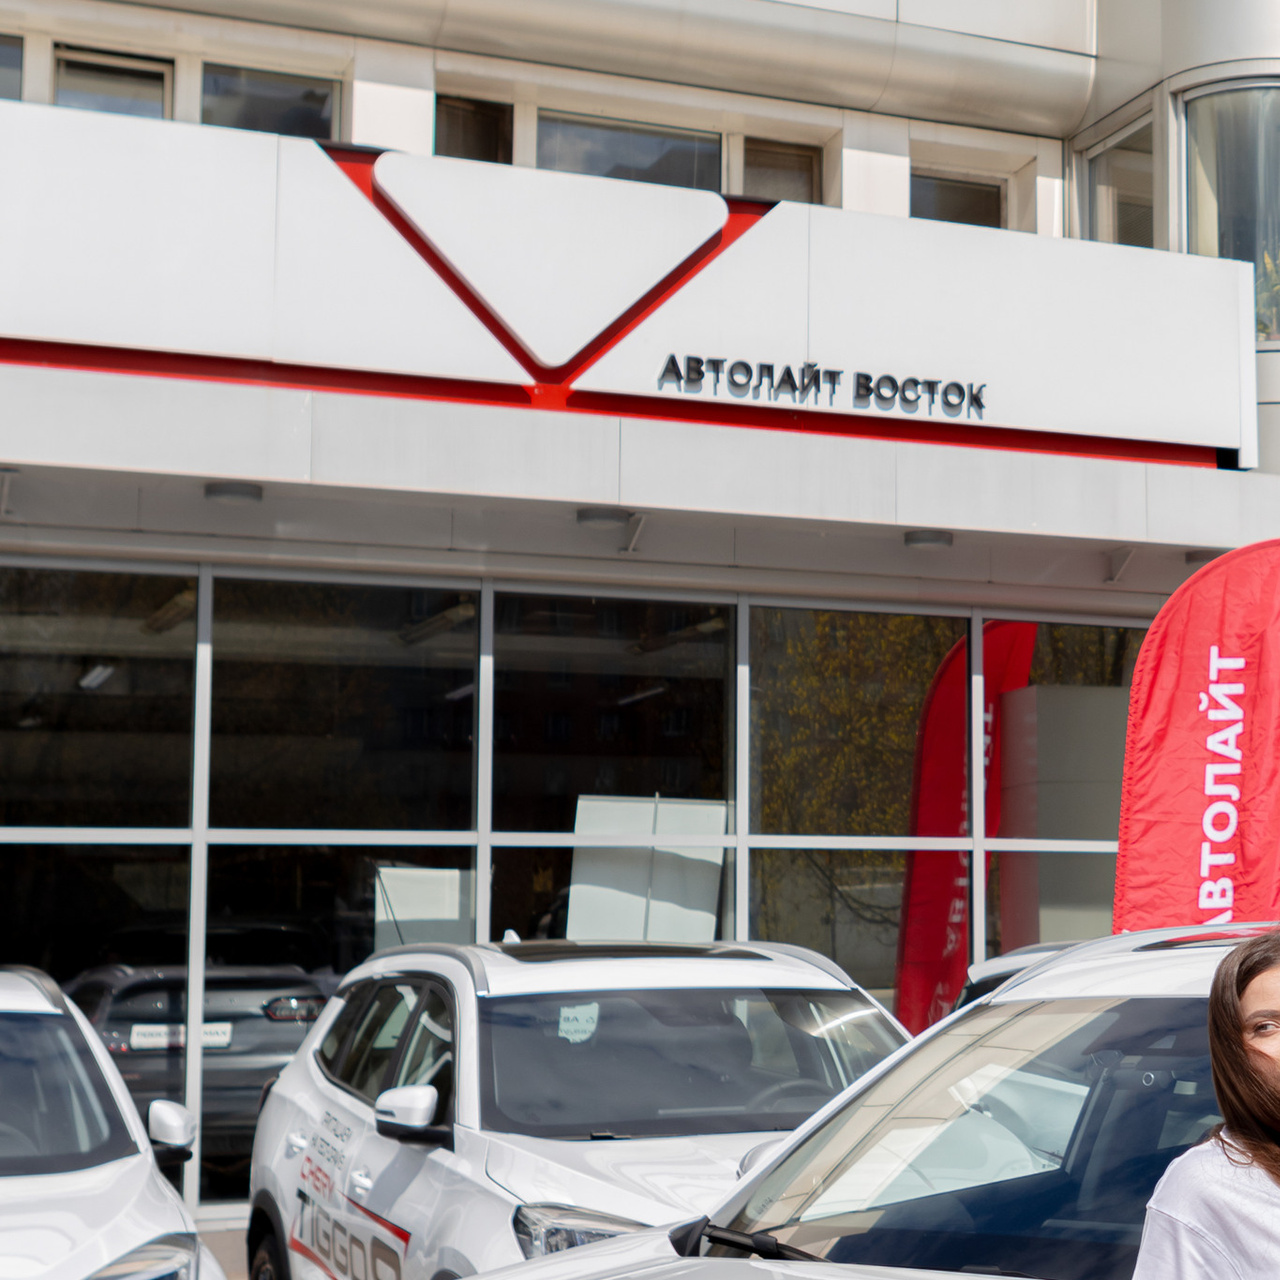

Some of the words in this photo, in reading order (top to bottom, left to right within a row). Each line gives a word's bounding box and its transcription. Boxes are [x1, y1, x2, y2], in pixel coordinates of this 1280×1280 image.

[657, 352, 844, 404] АВТОЛАЙТ
[853, 371, 987, 418] ВОСТОК
[300, 1155, 335, 1202] CHERY
